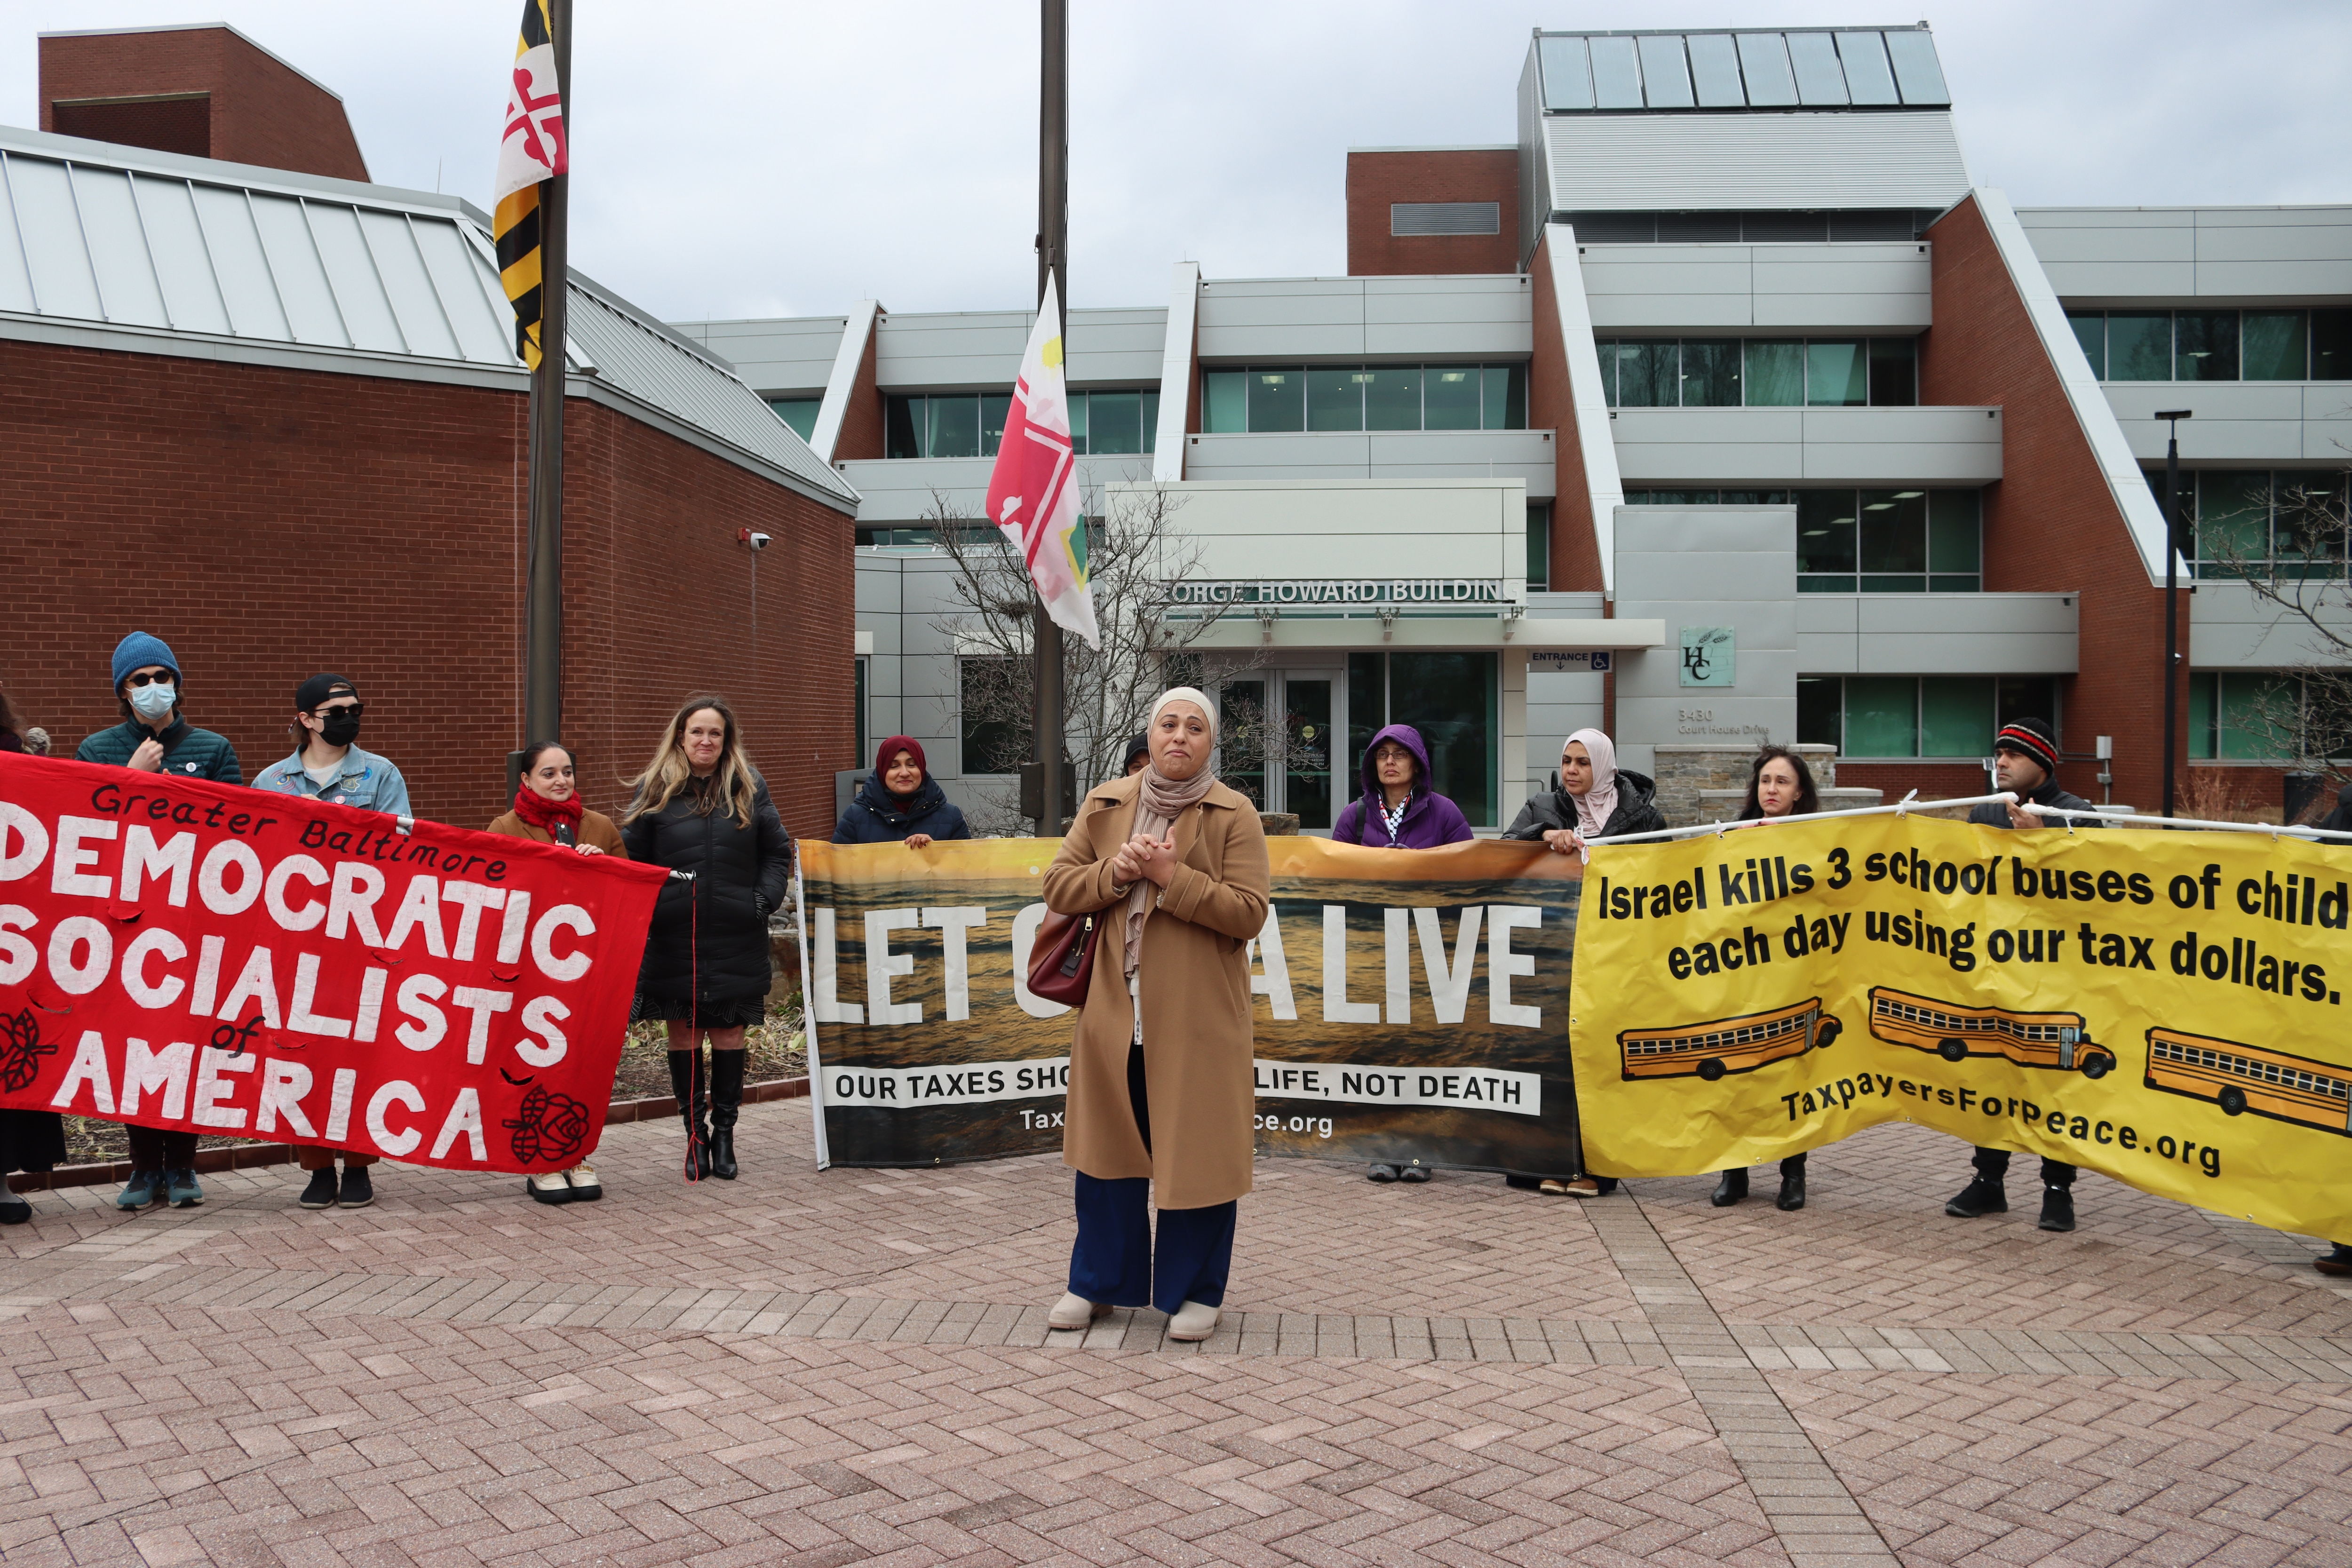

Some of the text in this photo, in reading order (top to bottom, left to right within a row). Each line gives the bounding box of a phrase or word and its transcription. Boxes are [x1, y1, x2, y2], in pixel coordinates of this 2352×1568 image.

[1258, 580, 1379, 602] HOWARD
[1393, 579, 1521, 601] BUILDING
[1532, 653, 1589, 661] ENTRANCE
[1678, 724, 1770, 734] Court House Drive
[1679, 709, 1714, 721] 3430
[91, 784, 507, 882] Greater Baltimore
[0, 801, 596, 982] DEMOCRATIC
[1599, 867, 1707, 920] Israel
[1719, 856, 1815, 906] kills
[1828, 847, 1851, 890] 3
[1865, 846, 2003, 895] school
[2012, 856, 2154, 905] buses
[2169, 864, 2221, 910] of
[0, 904, 571, 1067] SOCIALISTS
[813, 906, 987, 1026] LET
[1322, 905, 1542, 1028] LIVE
[1669, 909, 2341, 1006] each day using our tax dollars.
[212, 1015, 266, 1059] of
[51, 1030, 488, 1161] AMERICA
[835, 1065, 1521, 1105] OUR TAXES SHO LIFE, NOT DEATH
[1780, 1073, 2221, 1178] TaxpayersForPeace.org
